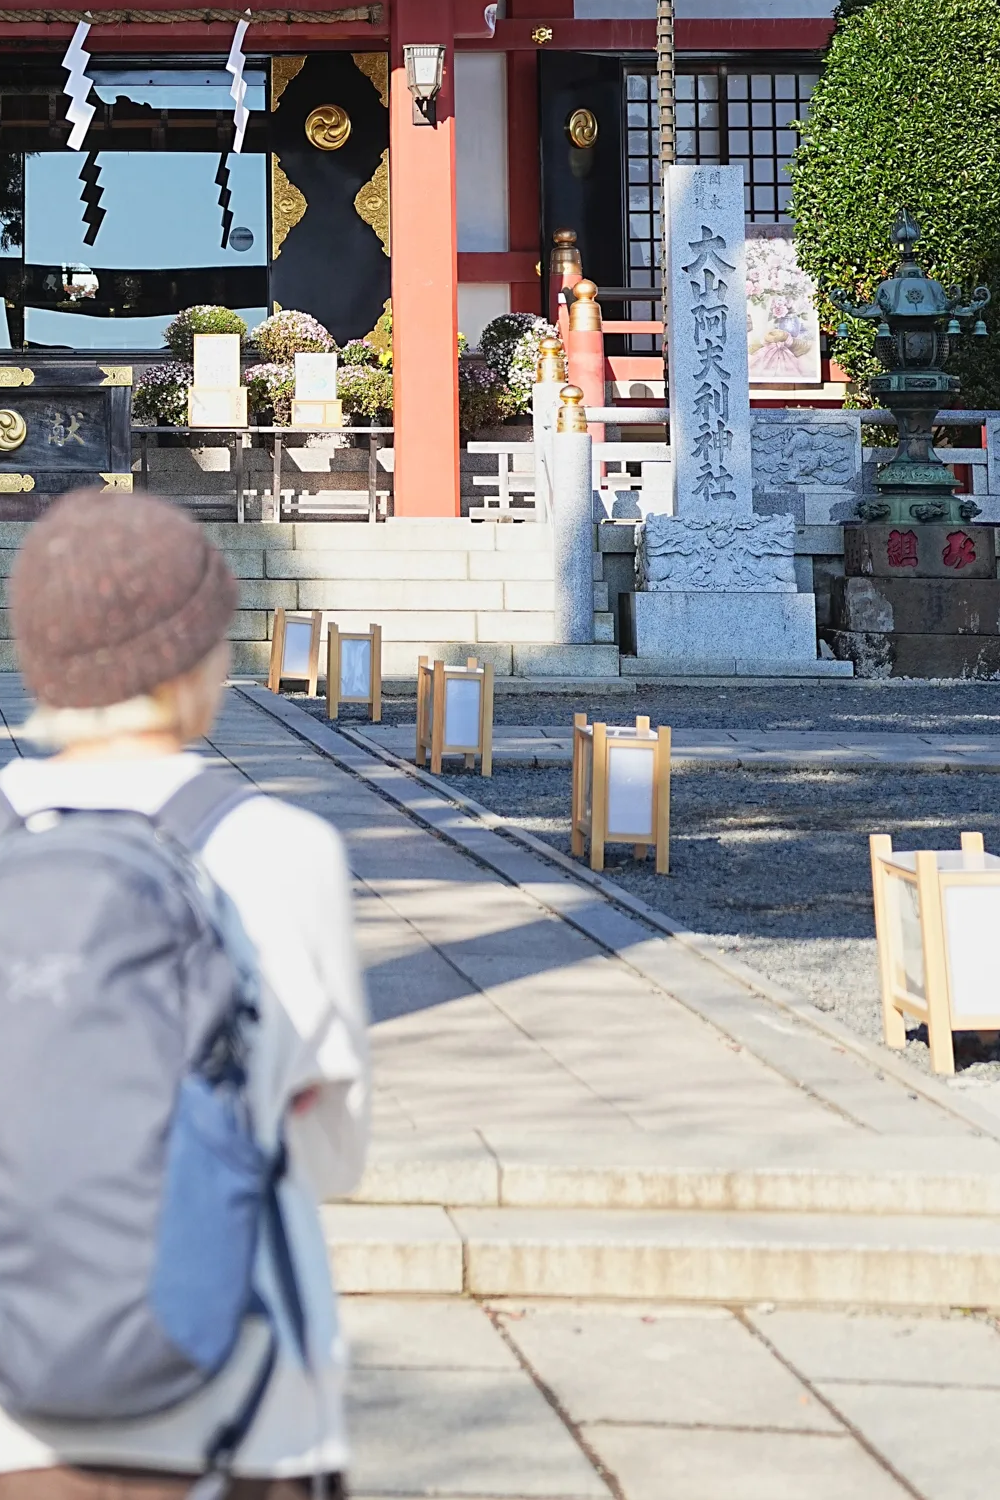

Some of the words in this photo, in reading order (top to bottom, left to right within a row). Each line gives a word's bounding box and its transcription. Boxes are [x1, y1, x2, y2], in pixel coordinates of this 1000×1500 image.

[681, 225, 737, 501] 大山阿夫利神社
